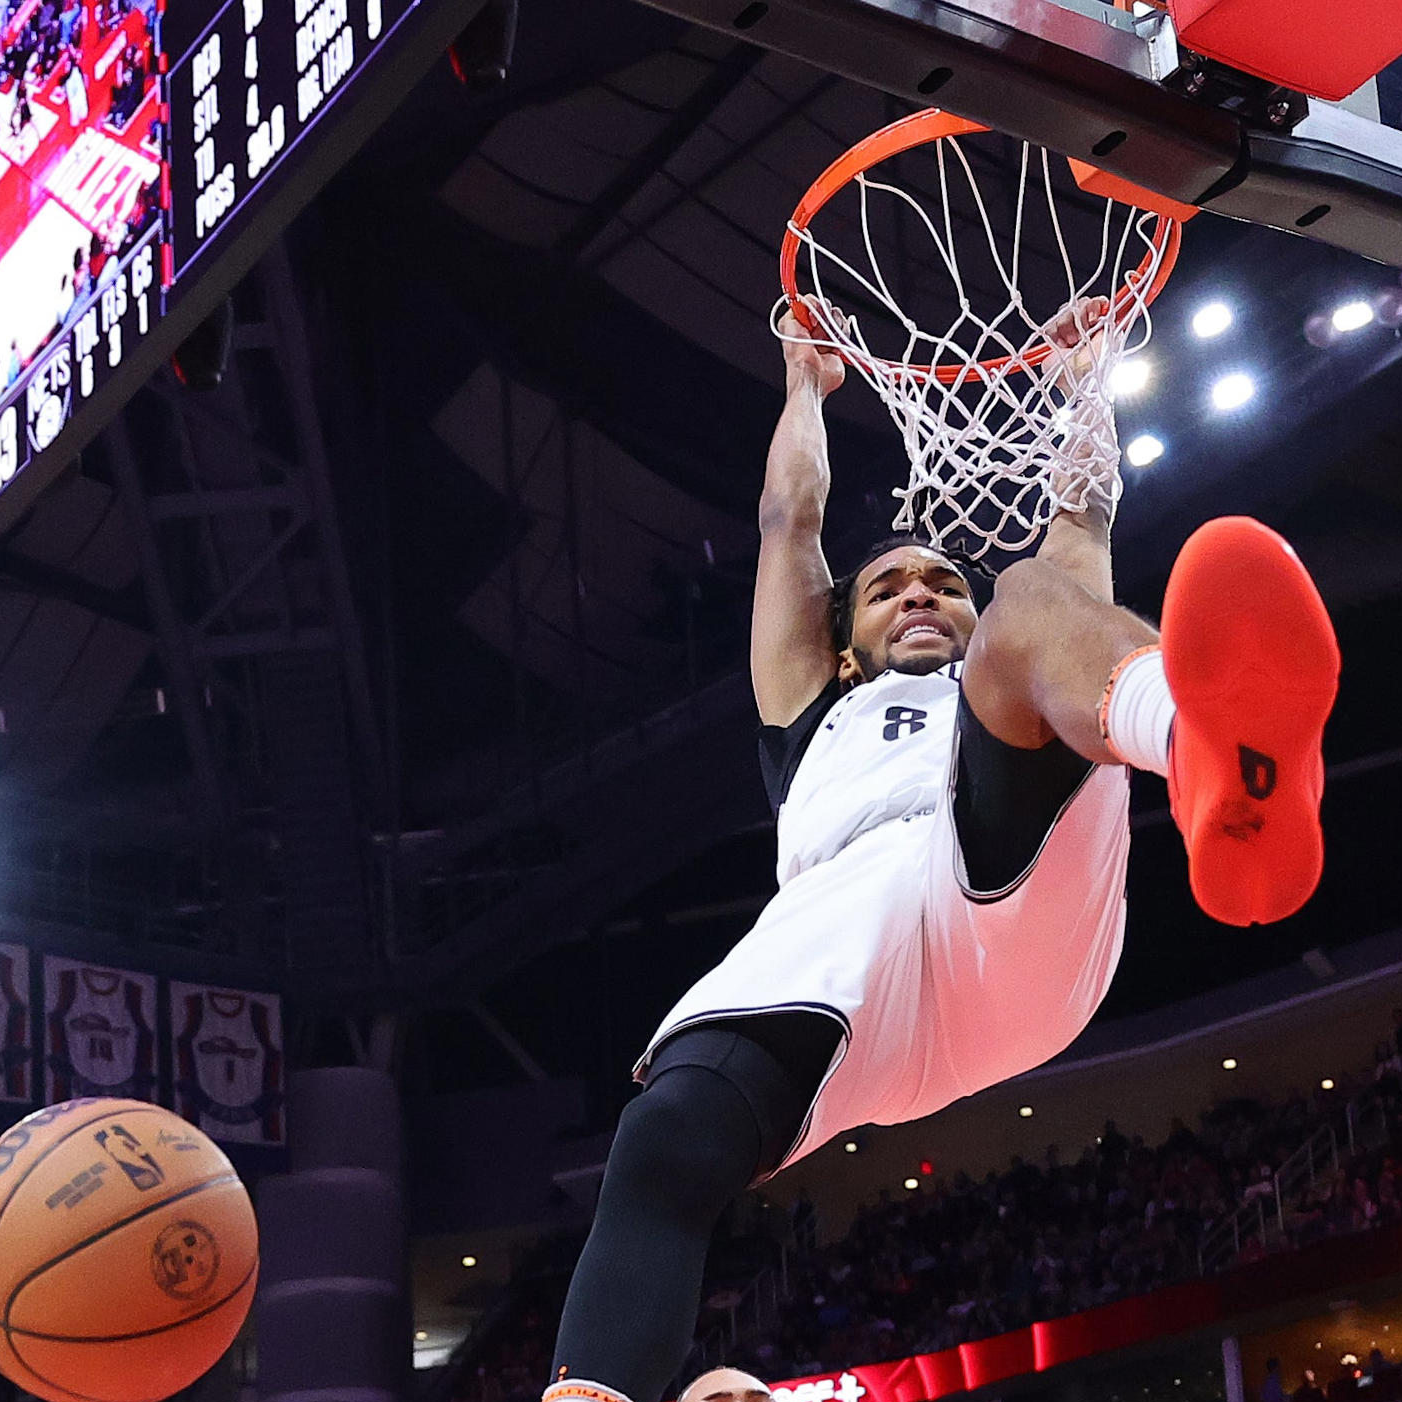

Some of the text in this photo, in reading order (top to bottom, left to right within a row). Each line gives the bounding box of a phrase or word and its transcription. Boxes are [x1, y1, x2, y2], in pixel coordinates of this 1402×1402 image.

[138, 293, 147, 335] 1
[28, 348, 71, 423] NETS
[883, 706, 928, 741] 8
